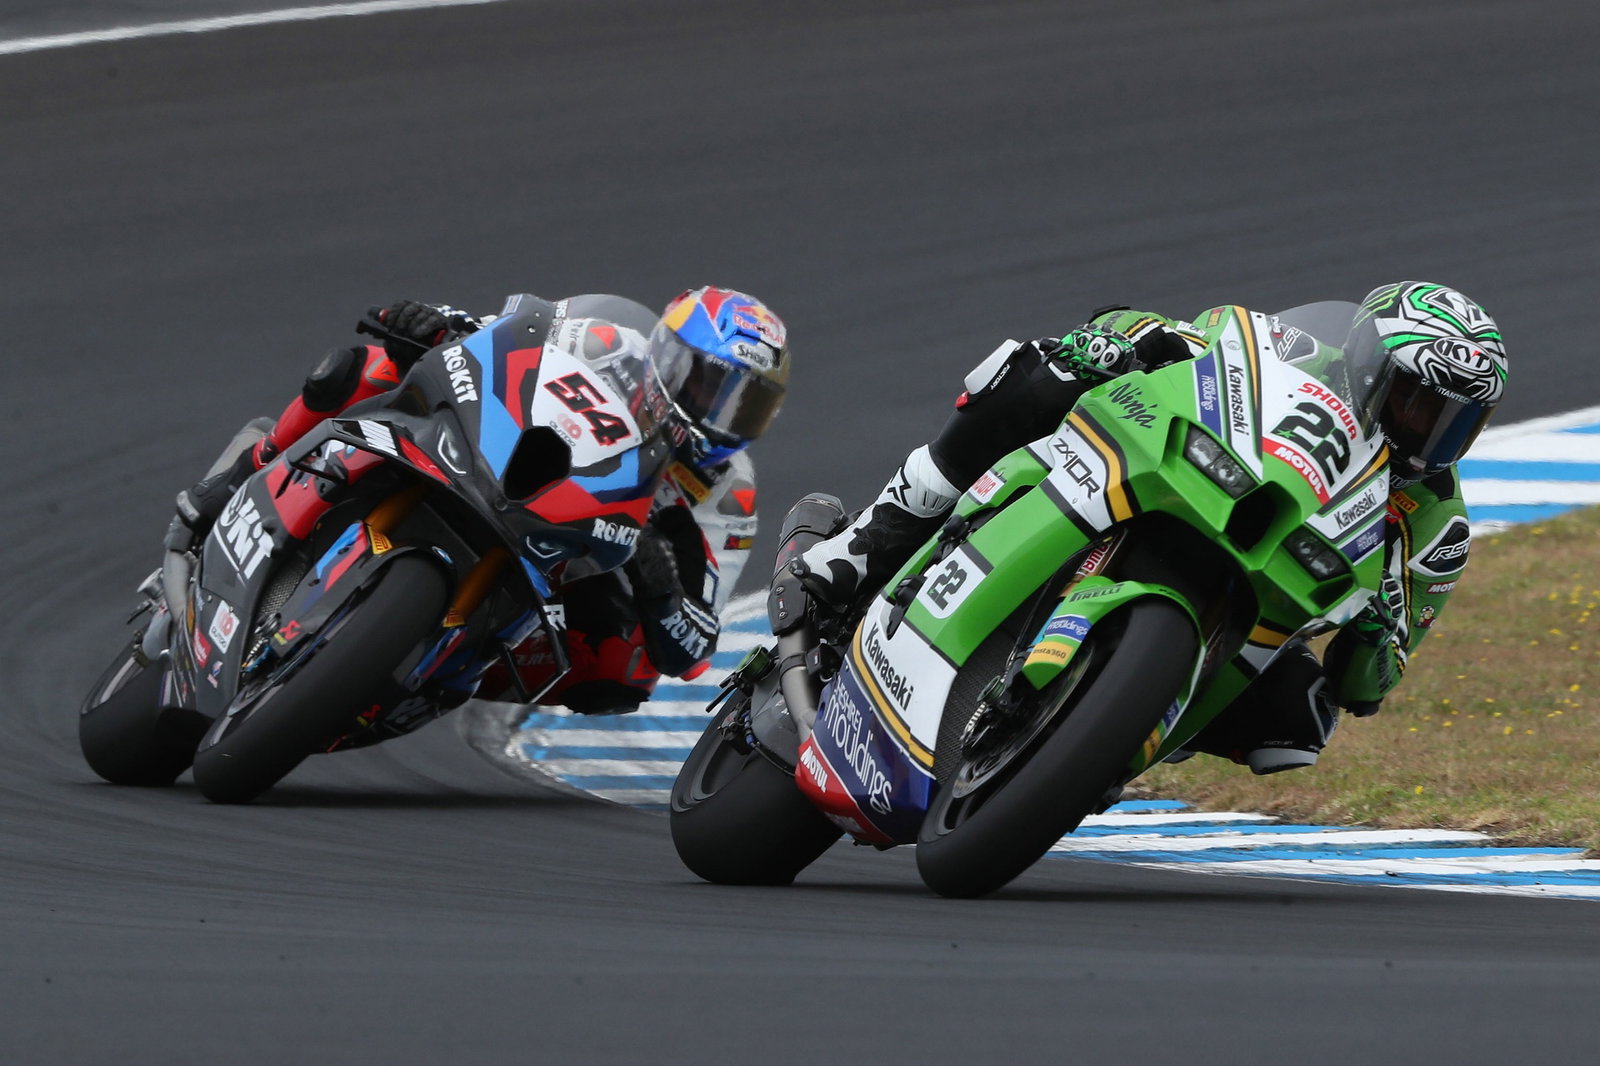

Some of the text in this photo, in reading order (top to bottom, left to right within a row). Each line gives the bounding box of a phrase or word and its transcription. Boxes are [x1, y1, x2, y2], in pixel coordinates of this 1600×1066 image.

[1440, 338, 1491, 369] KYT
[543, 371, 632, 447] 54
[1108, 382, 1158, 429] Ninja
[1228, 364, 1250, 436] Kawasaki
[1297, 382, 1357, 441] SHOWA
[549, 420, 576, 447] OUTDO
[1270, 401, 1350, 488] 22
[1273, 446, 1323, 495] MOTUL
[1334, 489, 1377, 531] Kawasaki
[926, 560, 968, 611] 22
[1069, 583, 1125, 603] PIRELLI
[865, 622, 914, 711] Kawasaki
[800, 746, 828, 793] MOTUL
[825, 693, 893, 816] mouldings
